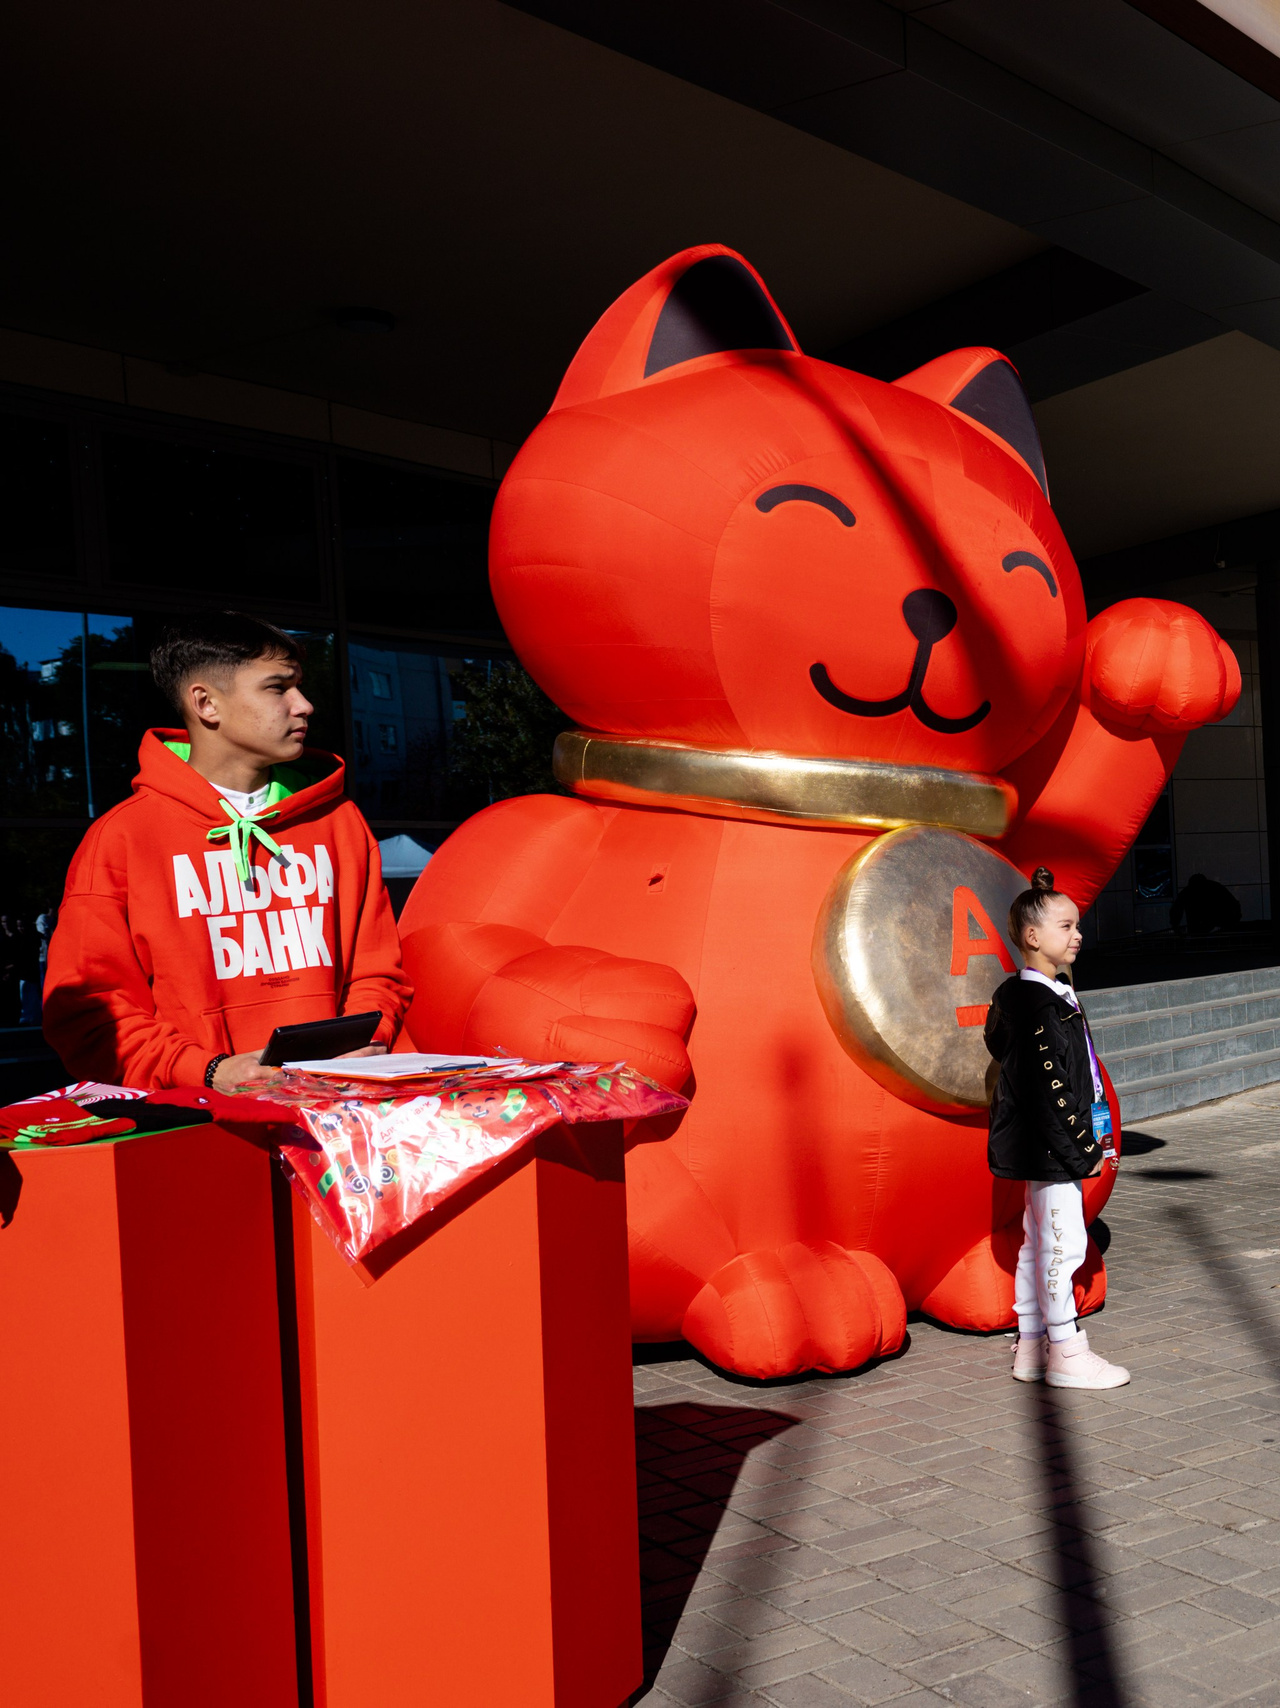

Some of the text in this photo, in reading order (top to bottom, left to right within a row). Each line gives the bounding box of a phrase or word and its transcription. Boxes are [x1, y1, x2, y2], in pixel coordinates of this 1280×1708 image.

[173, 844, 334, 918] АЛЬФА
[206, 905, 333, 980] БАНК
[1047, 1208, 1063, 1301] FLYSPORT
